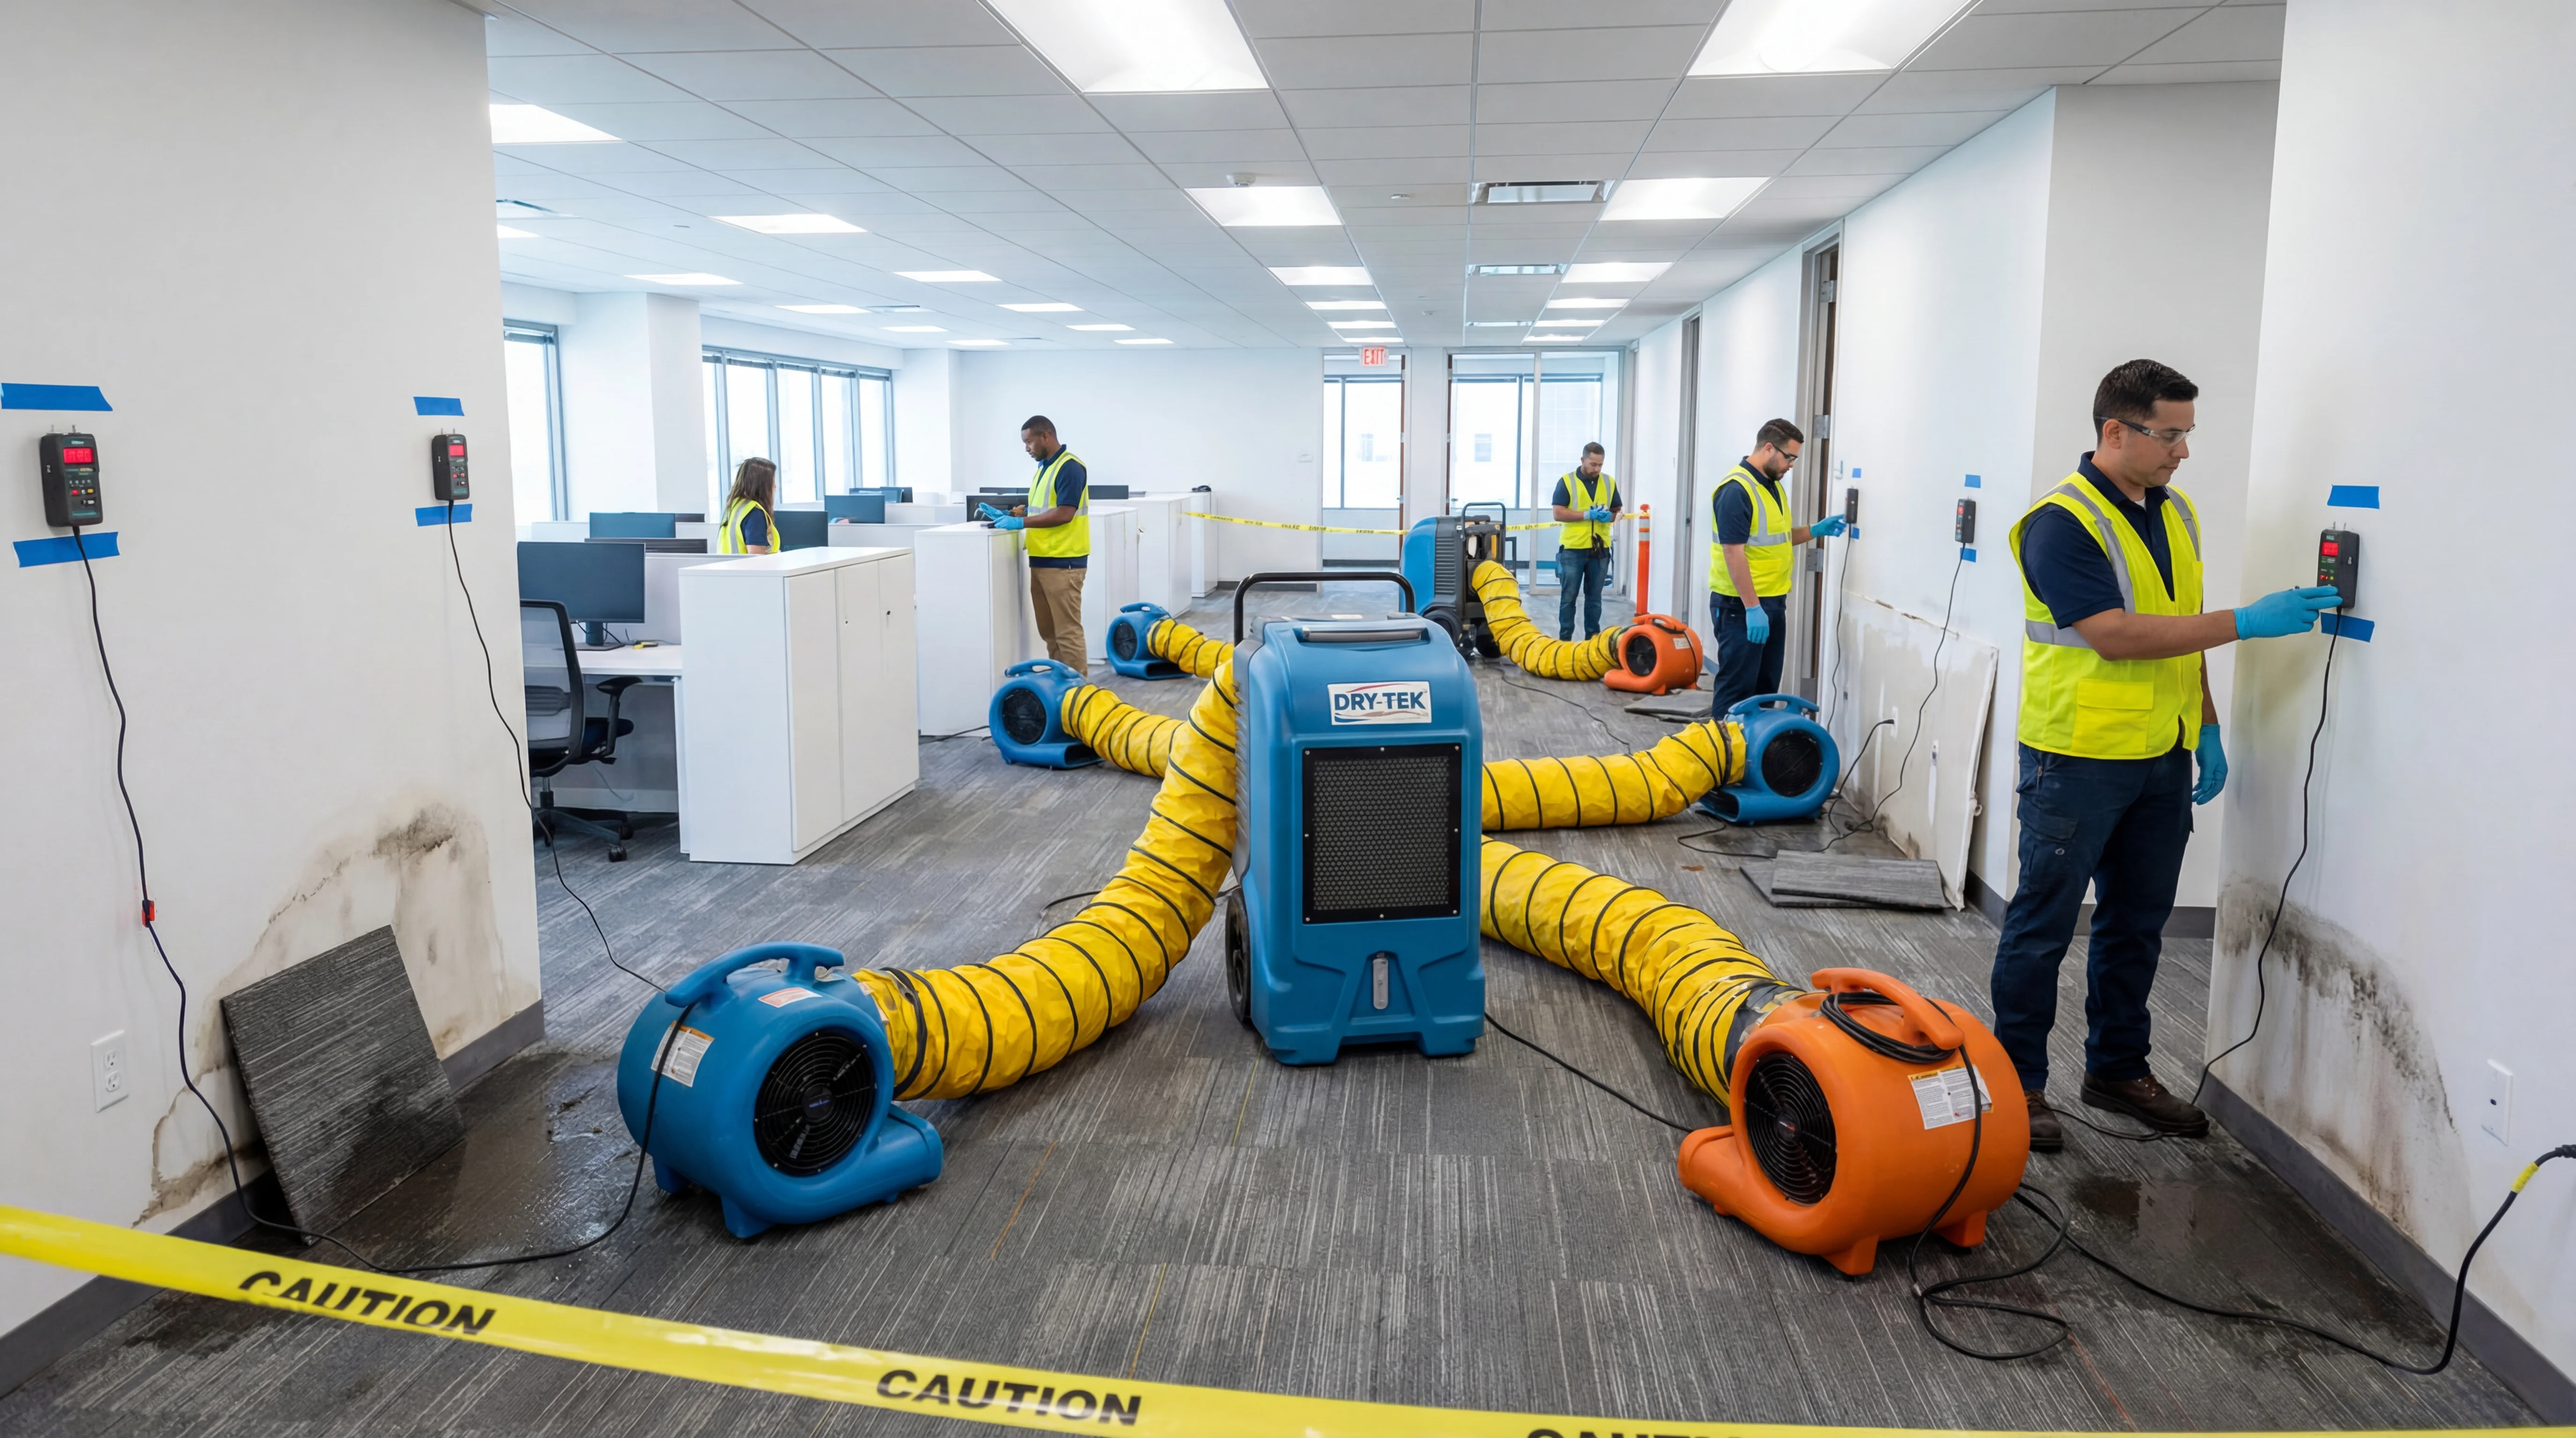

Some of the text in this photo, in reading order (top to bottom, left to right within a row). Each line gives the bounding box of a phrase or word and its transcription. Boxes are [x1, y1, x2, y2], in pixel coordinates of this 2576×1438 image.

[1364, 349, 1384, 365] EXIT
[1334, 692, 1426, 711] DRY-TEK
[238, 1271, 497, 1336] CAUTION
[877, 1370, 1142, 1426] CAUTION
